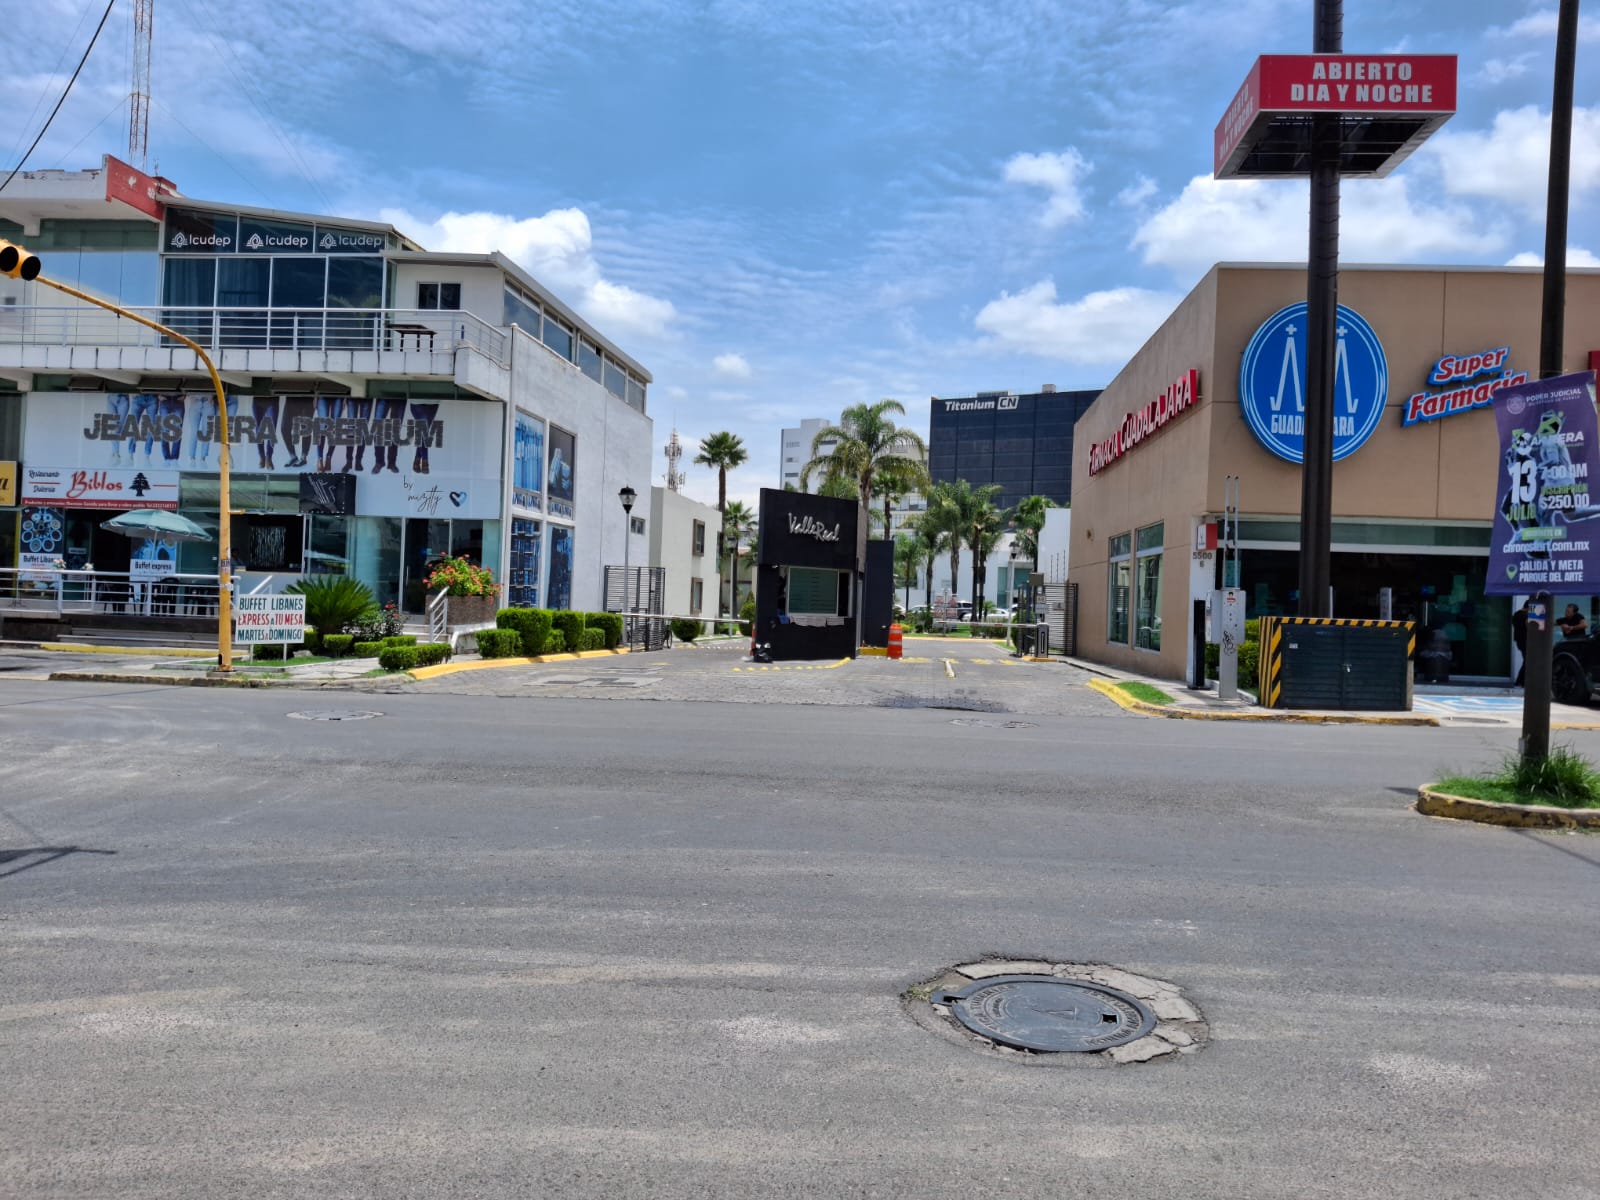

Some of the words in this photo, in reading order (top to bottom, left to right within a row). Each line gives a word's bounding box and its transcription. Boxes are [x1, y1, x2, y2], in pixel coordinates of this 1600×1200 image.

[1312, 62, 1413, 81] ABIERTO
[1290, 84, 1330, 102] DIA
[1336, 84, 1350, 102] Y
[1355, 84, 1433, 103] NOCHE
[189, 234, 231, 247] Icudep
[265, 234, 309, 248] Icudep
[1433, 349, 1507, 381] Super
[944, 399, 996, 411] Titanium
[999, 397, 1018, 409] CN
[1569, 463, 1588, 478] AM
[65, 470, 123, 498] Biblos
[1508, 461, 1537, 503] 13
[1540, 494, 1590, 509] $250.00
[1192, 551, 1213, 560] 5500
[1519, 560, 1548, 571] SALIDA
[1550, 560, 1557, 571] Y
[1558, 559, 1584, 570] META
[1519, 572, 1548, 582] PARQUE
[1549, 572, 1563, 582] DEL
[1564, 571, 1584, 582] ARTE
[239, 598, 267, 611] BUFFET
[271, 598, 304, 611] LIBANES
[237, 613, 270, 626] EXPRESS
[284, 613, 304, 626] MESA
[237, 629, 265, 641] MARTES
[269, 629, 302, 641] DOMINGO
